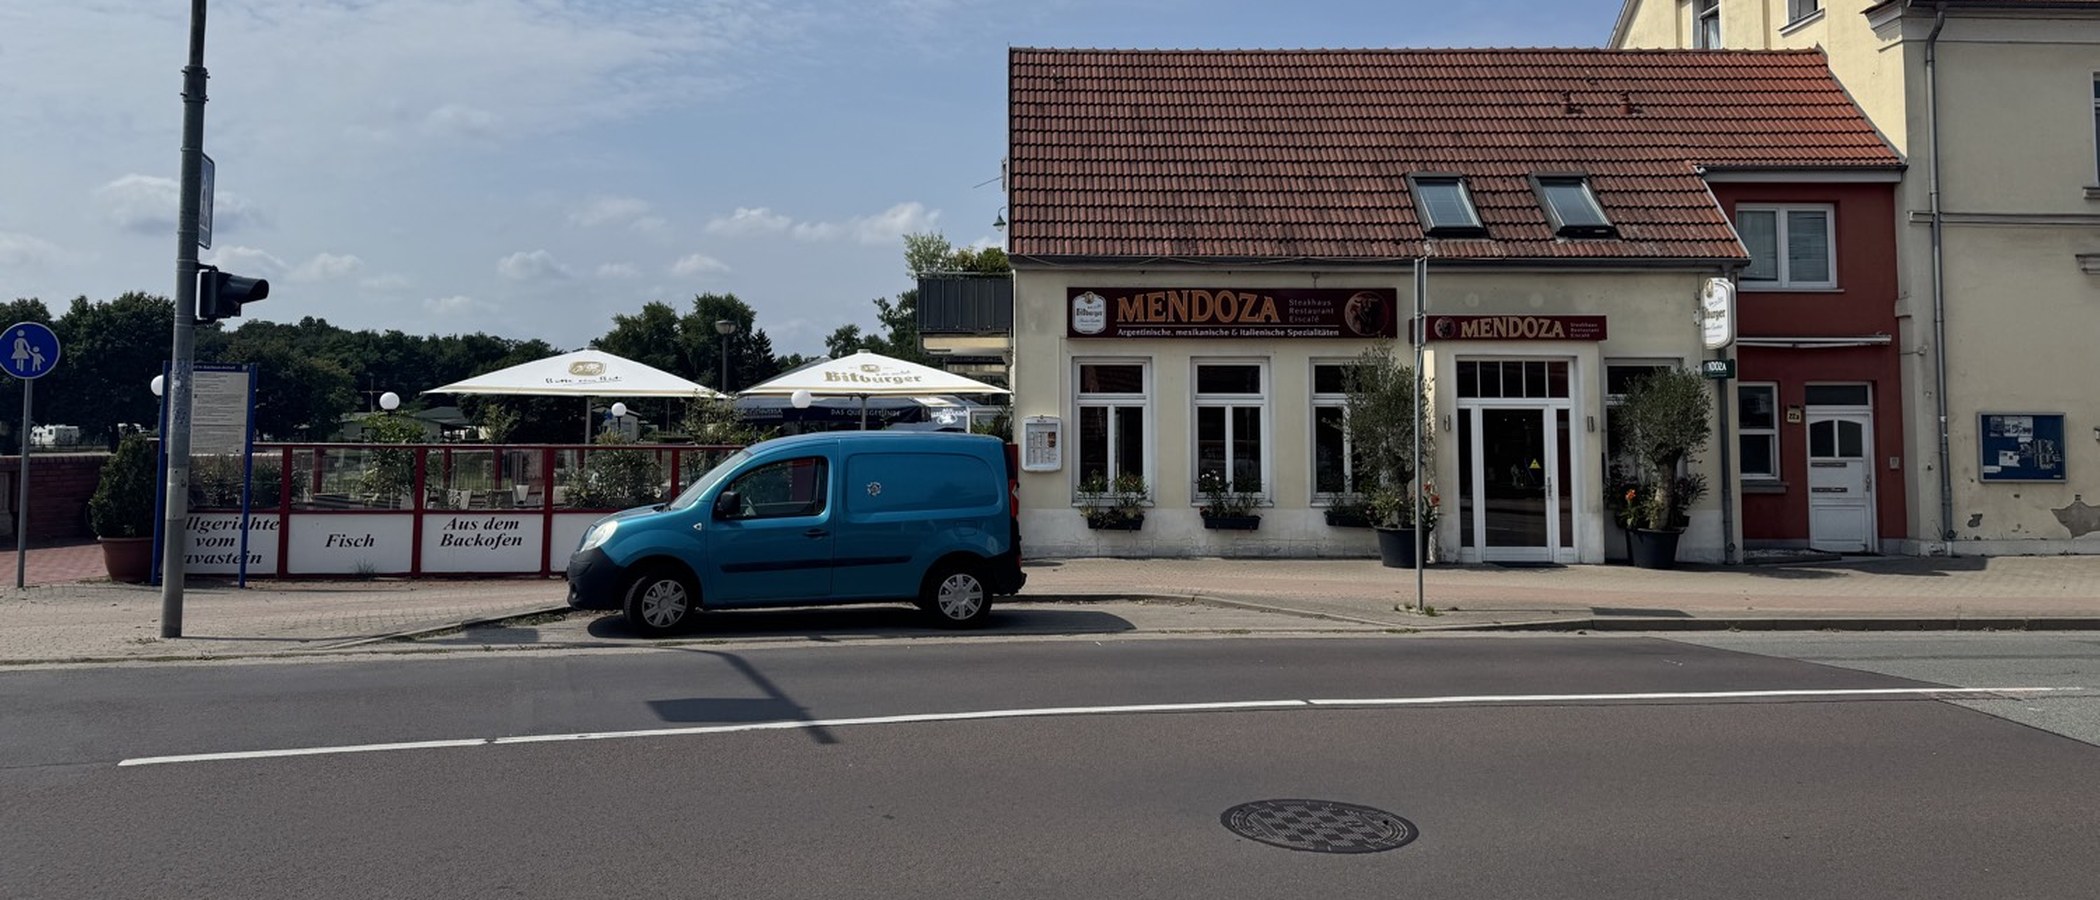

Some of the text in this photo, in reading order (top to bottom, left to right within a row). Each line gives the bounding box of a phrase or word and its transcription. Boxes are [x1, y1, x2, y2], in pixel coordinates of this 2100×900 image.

[1116, 289, 1281, 323] MENDOZA
[1288, 298, 1332, 306] Steakhaus
[1288, 307, 1334, 315] Restaurant
[1117, 328, 1339, 337] Argentinische, mexikanische & italienische Spezialitäten
[1460, 316, 1565, 339] MENDOZA
[823, 370, 922, 385] Bitburger
[443, 516, 520, 531] Aus dem
[195, 536, 236, 547] vom
[325, 533, 375, 548] Fisch
[440, 532, 523, 550] Backofen
